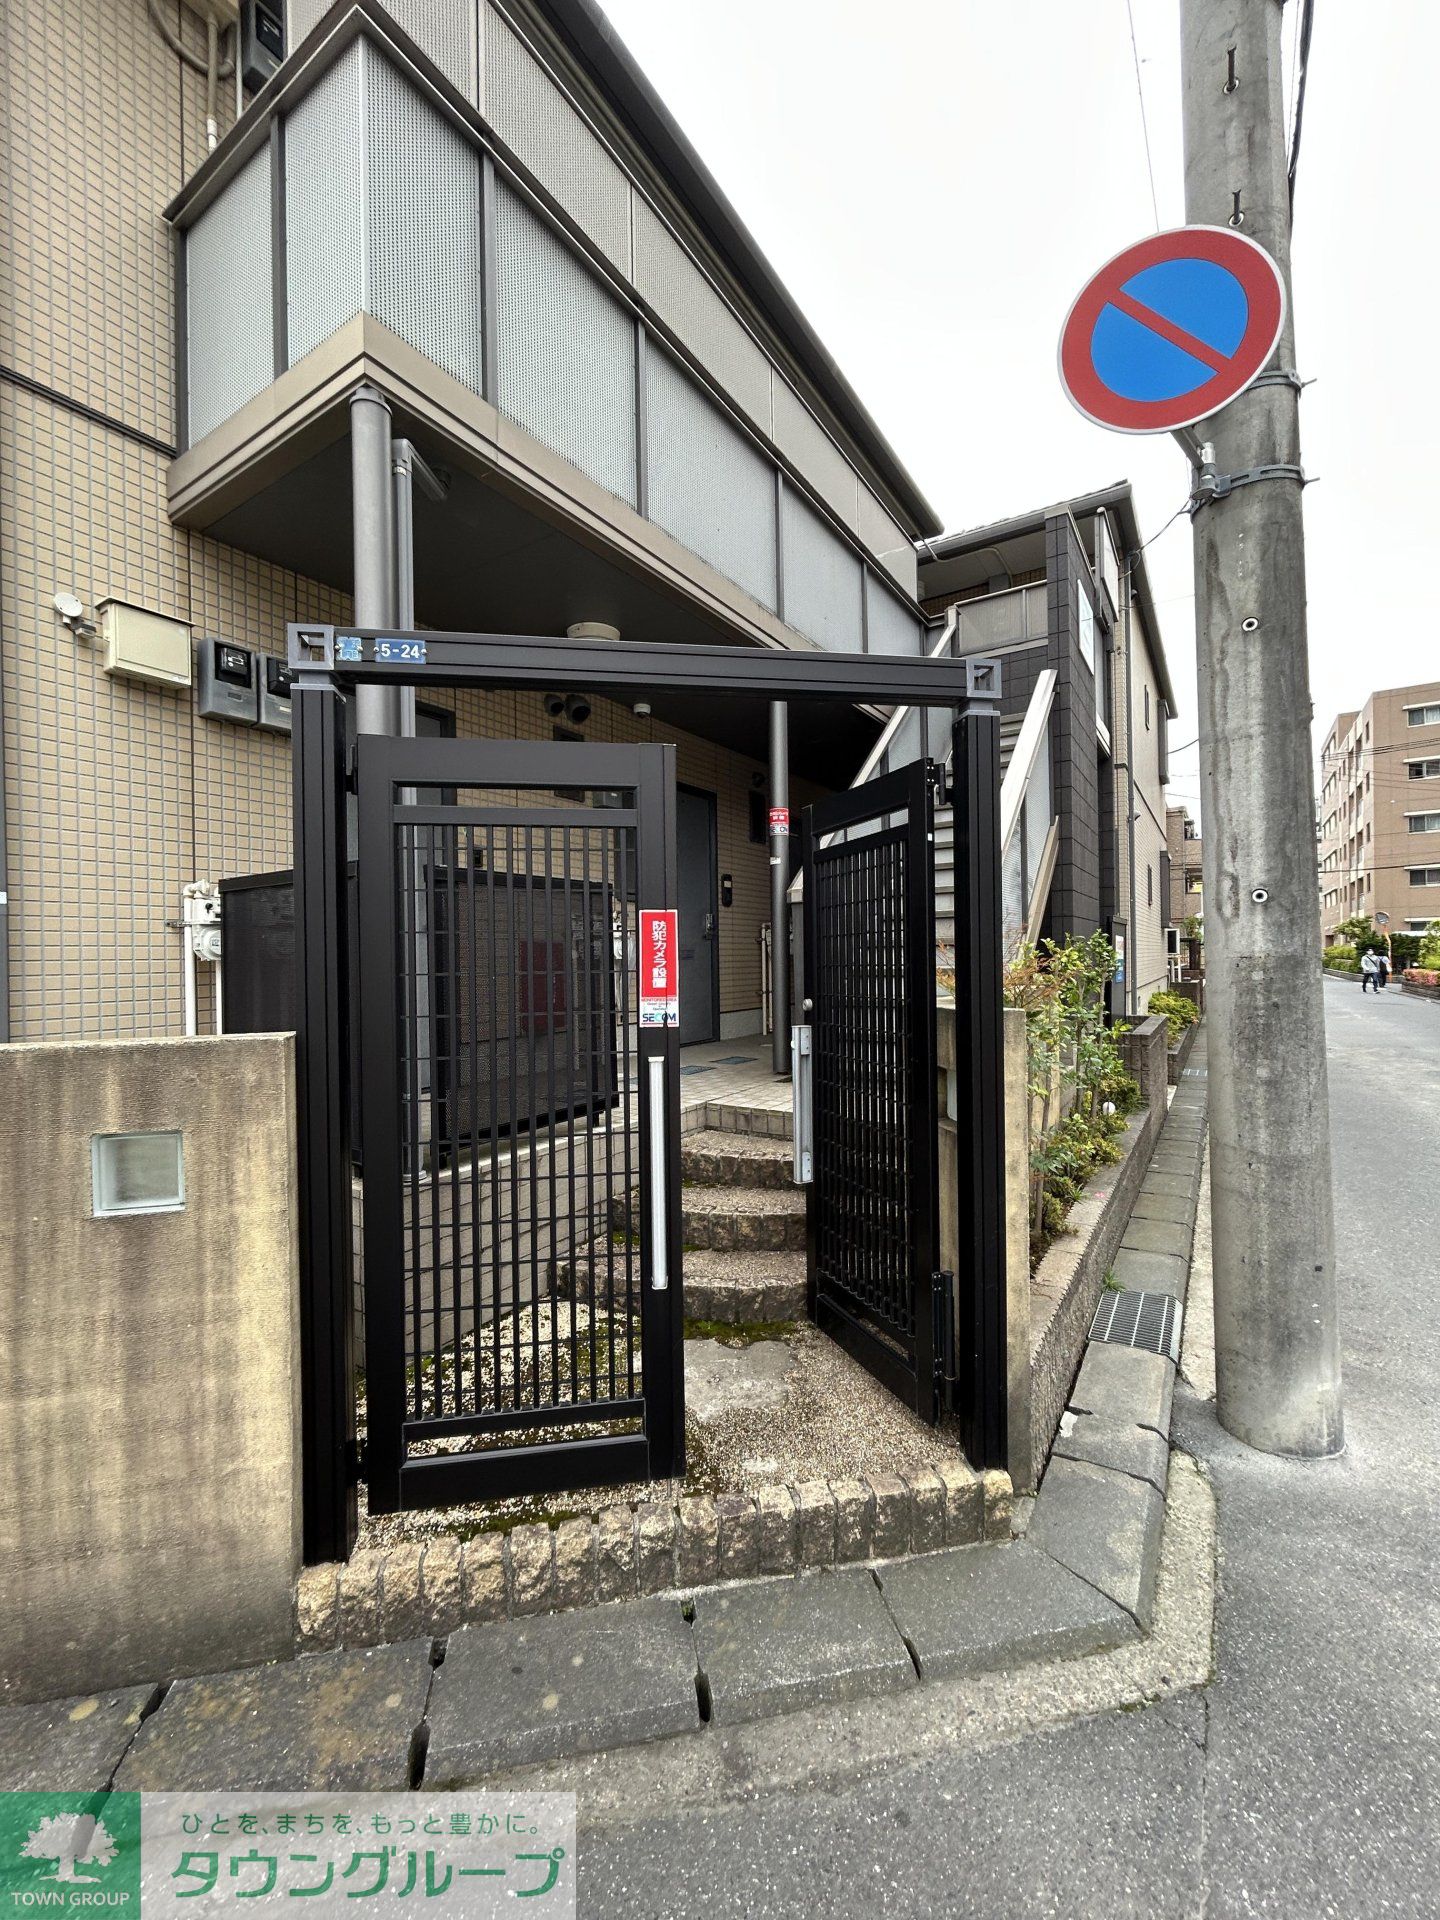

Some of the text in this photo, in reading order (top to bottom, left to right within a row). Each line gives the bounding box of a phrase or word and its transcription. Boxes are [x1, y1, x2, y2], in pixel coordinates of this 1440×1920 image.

[381, 643, 420, 659] 5-24
[652, 920, 667, 989] 防犯カメラ設置
[642, 1013, 676, 1022] SECOM
